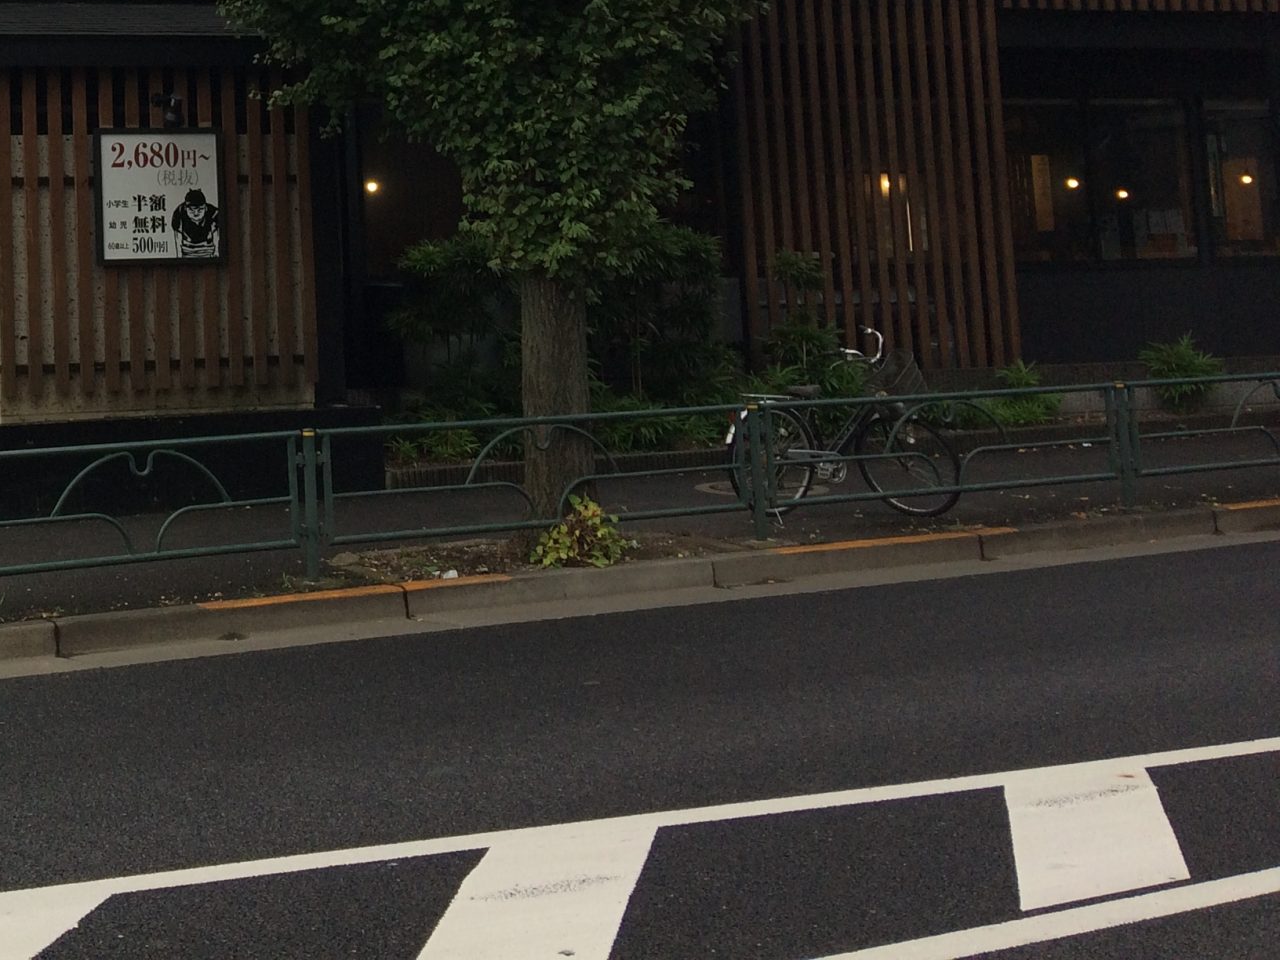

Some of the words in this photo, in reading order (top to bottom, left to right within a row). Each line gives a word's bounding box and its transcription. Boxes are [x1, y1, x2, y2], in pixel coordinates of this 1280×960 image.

[106, 200, 130, 209] 小学生
[132, 194, 167, 213] 半額
[132, 215, 168, 234] 無料
[132, 236, 169, 254] 500円引
